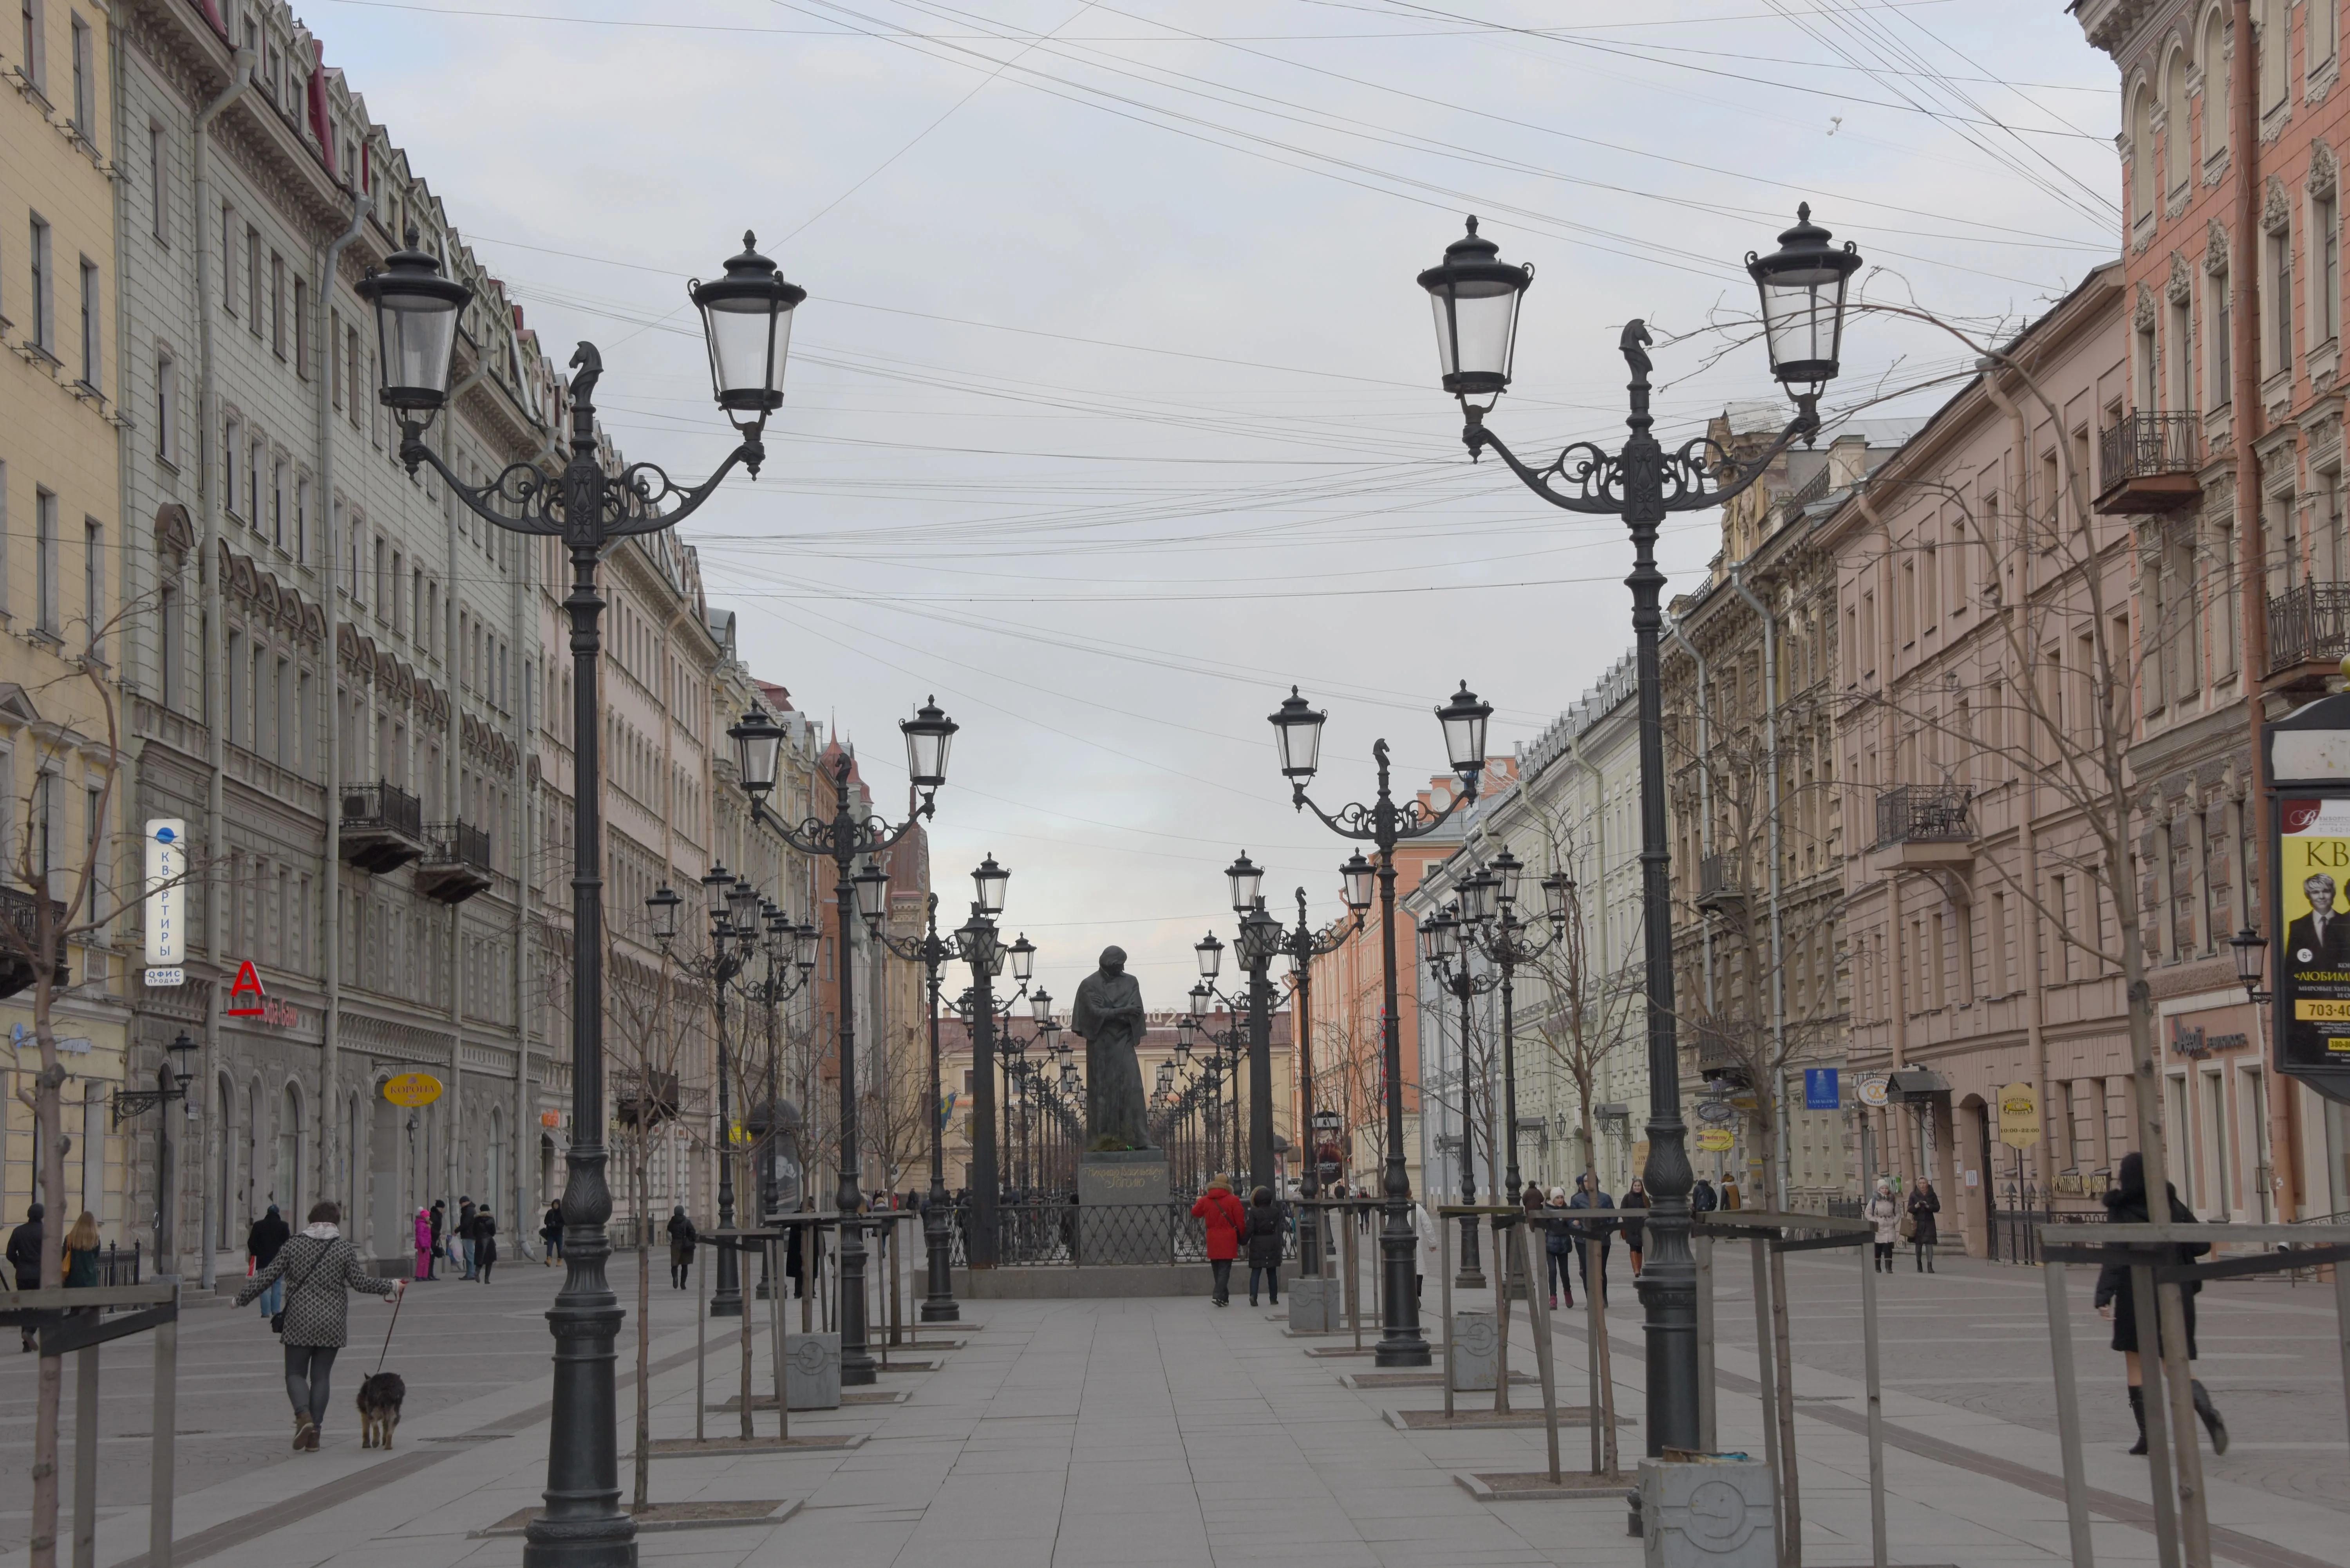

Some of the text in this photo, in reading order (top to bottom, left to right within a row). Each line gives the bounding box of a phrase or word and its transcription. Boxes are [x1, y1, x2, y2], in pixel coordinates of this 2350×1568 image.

[160, 852, 170, 956] КВРТИРЫ
[2294, 971, 2350, 981] «ЛЮБИМ
[390, 1085, 434, 1094] КОРОНА
